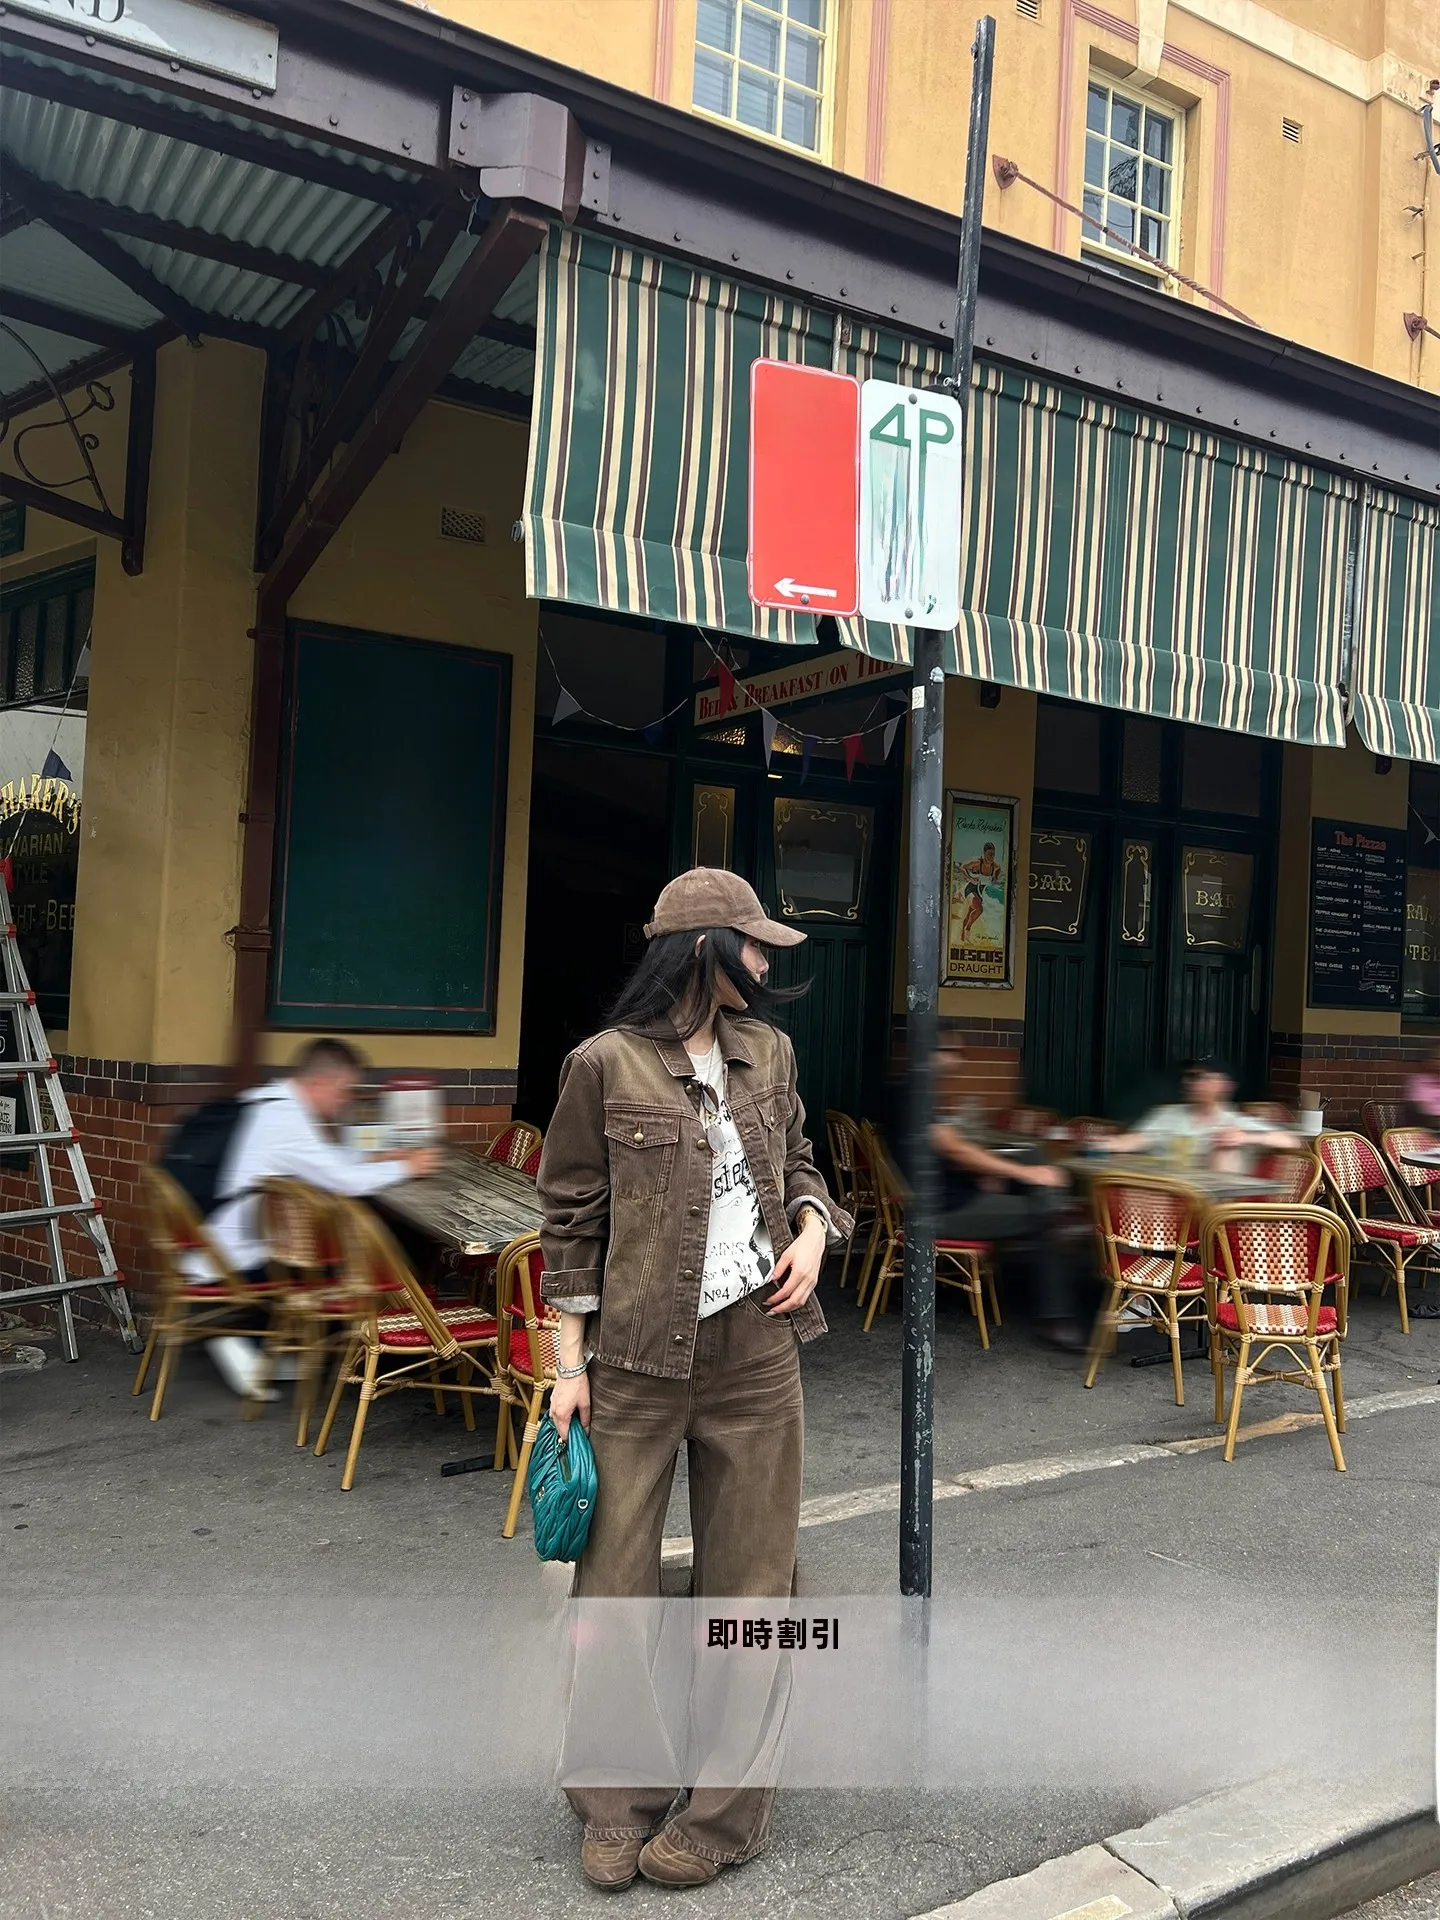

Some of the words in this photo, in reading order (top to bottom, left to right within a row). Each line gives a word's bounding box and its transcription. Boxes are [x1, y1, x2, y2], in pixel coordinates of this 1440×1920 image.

[869, 403, 954, 456] 4P
[743, 671, 823, 708] BREAKFAST
[1334, 830, 1354, 846] The
[1355, 833, 1387, 851] Pizzas
[1195, 890, 1237, 908] BAR
[1404, 944, 1440, 962] TEL
[949, 962, 1003, 974] DRAUGHT
